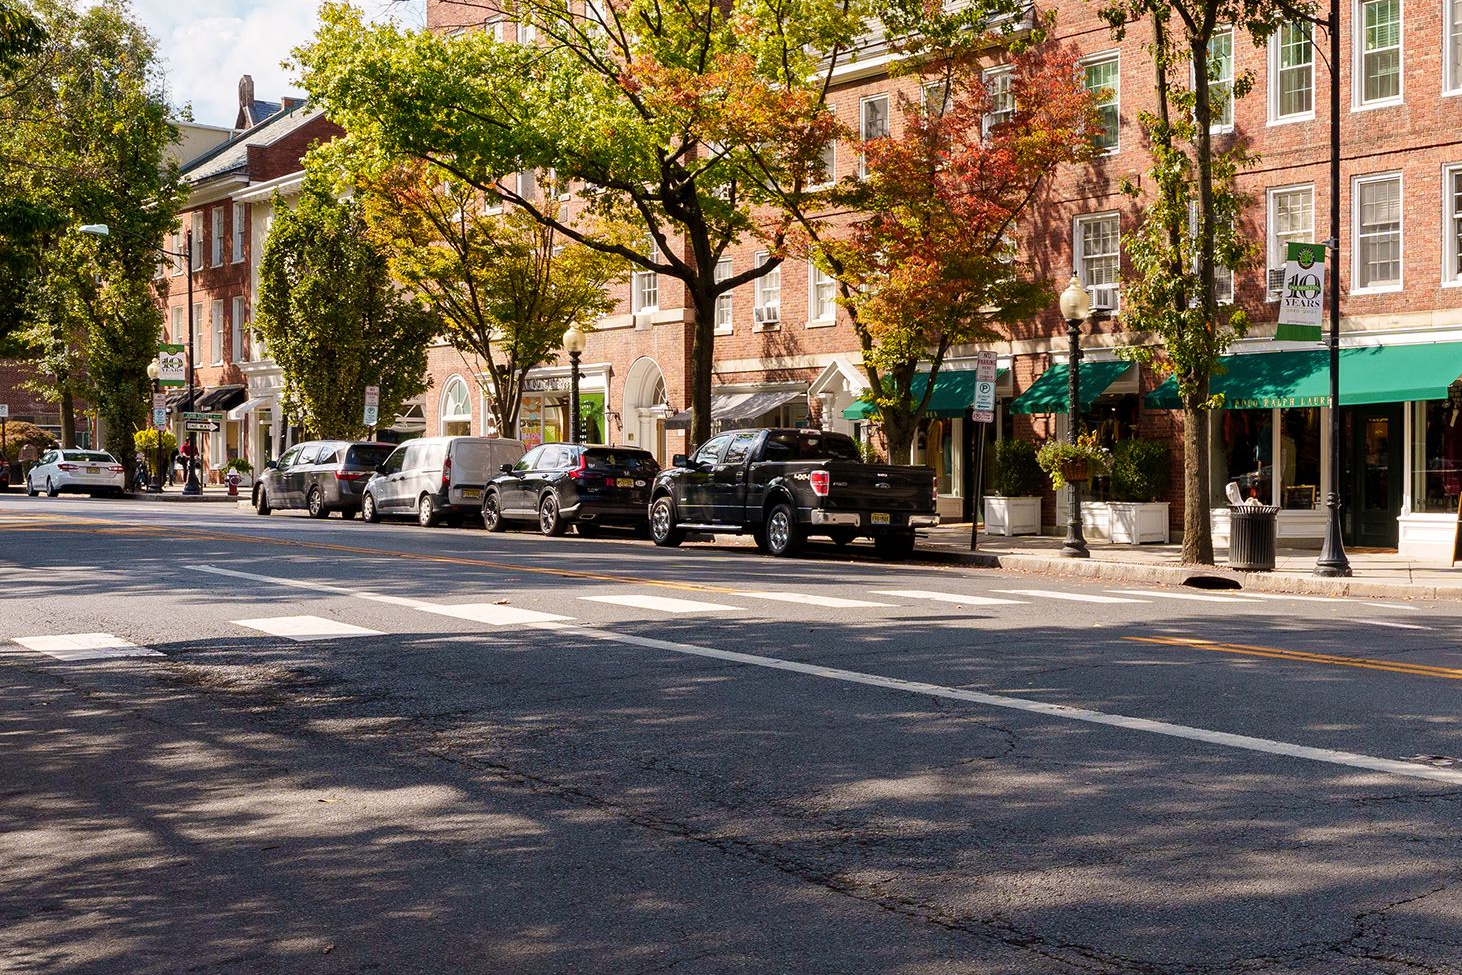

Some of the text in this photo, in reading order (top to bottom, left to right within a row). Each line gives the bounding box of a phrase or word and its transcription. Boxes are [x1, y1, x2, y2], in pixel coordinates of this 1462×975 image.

[1286, 273, 1321, 300] 10
[1285, 298, 1320, 308] YEARS
[161, 357, 183, 369] 10
[1263, 397, 1295, 407] RALPH
[1300, 396, 1332, 406] LAURE
